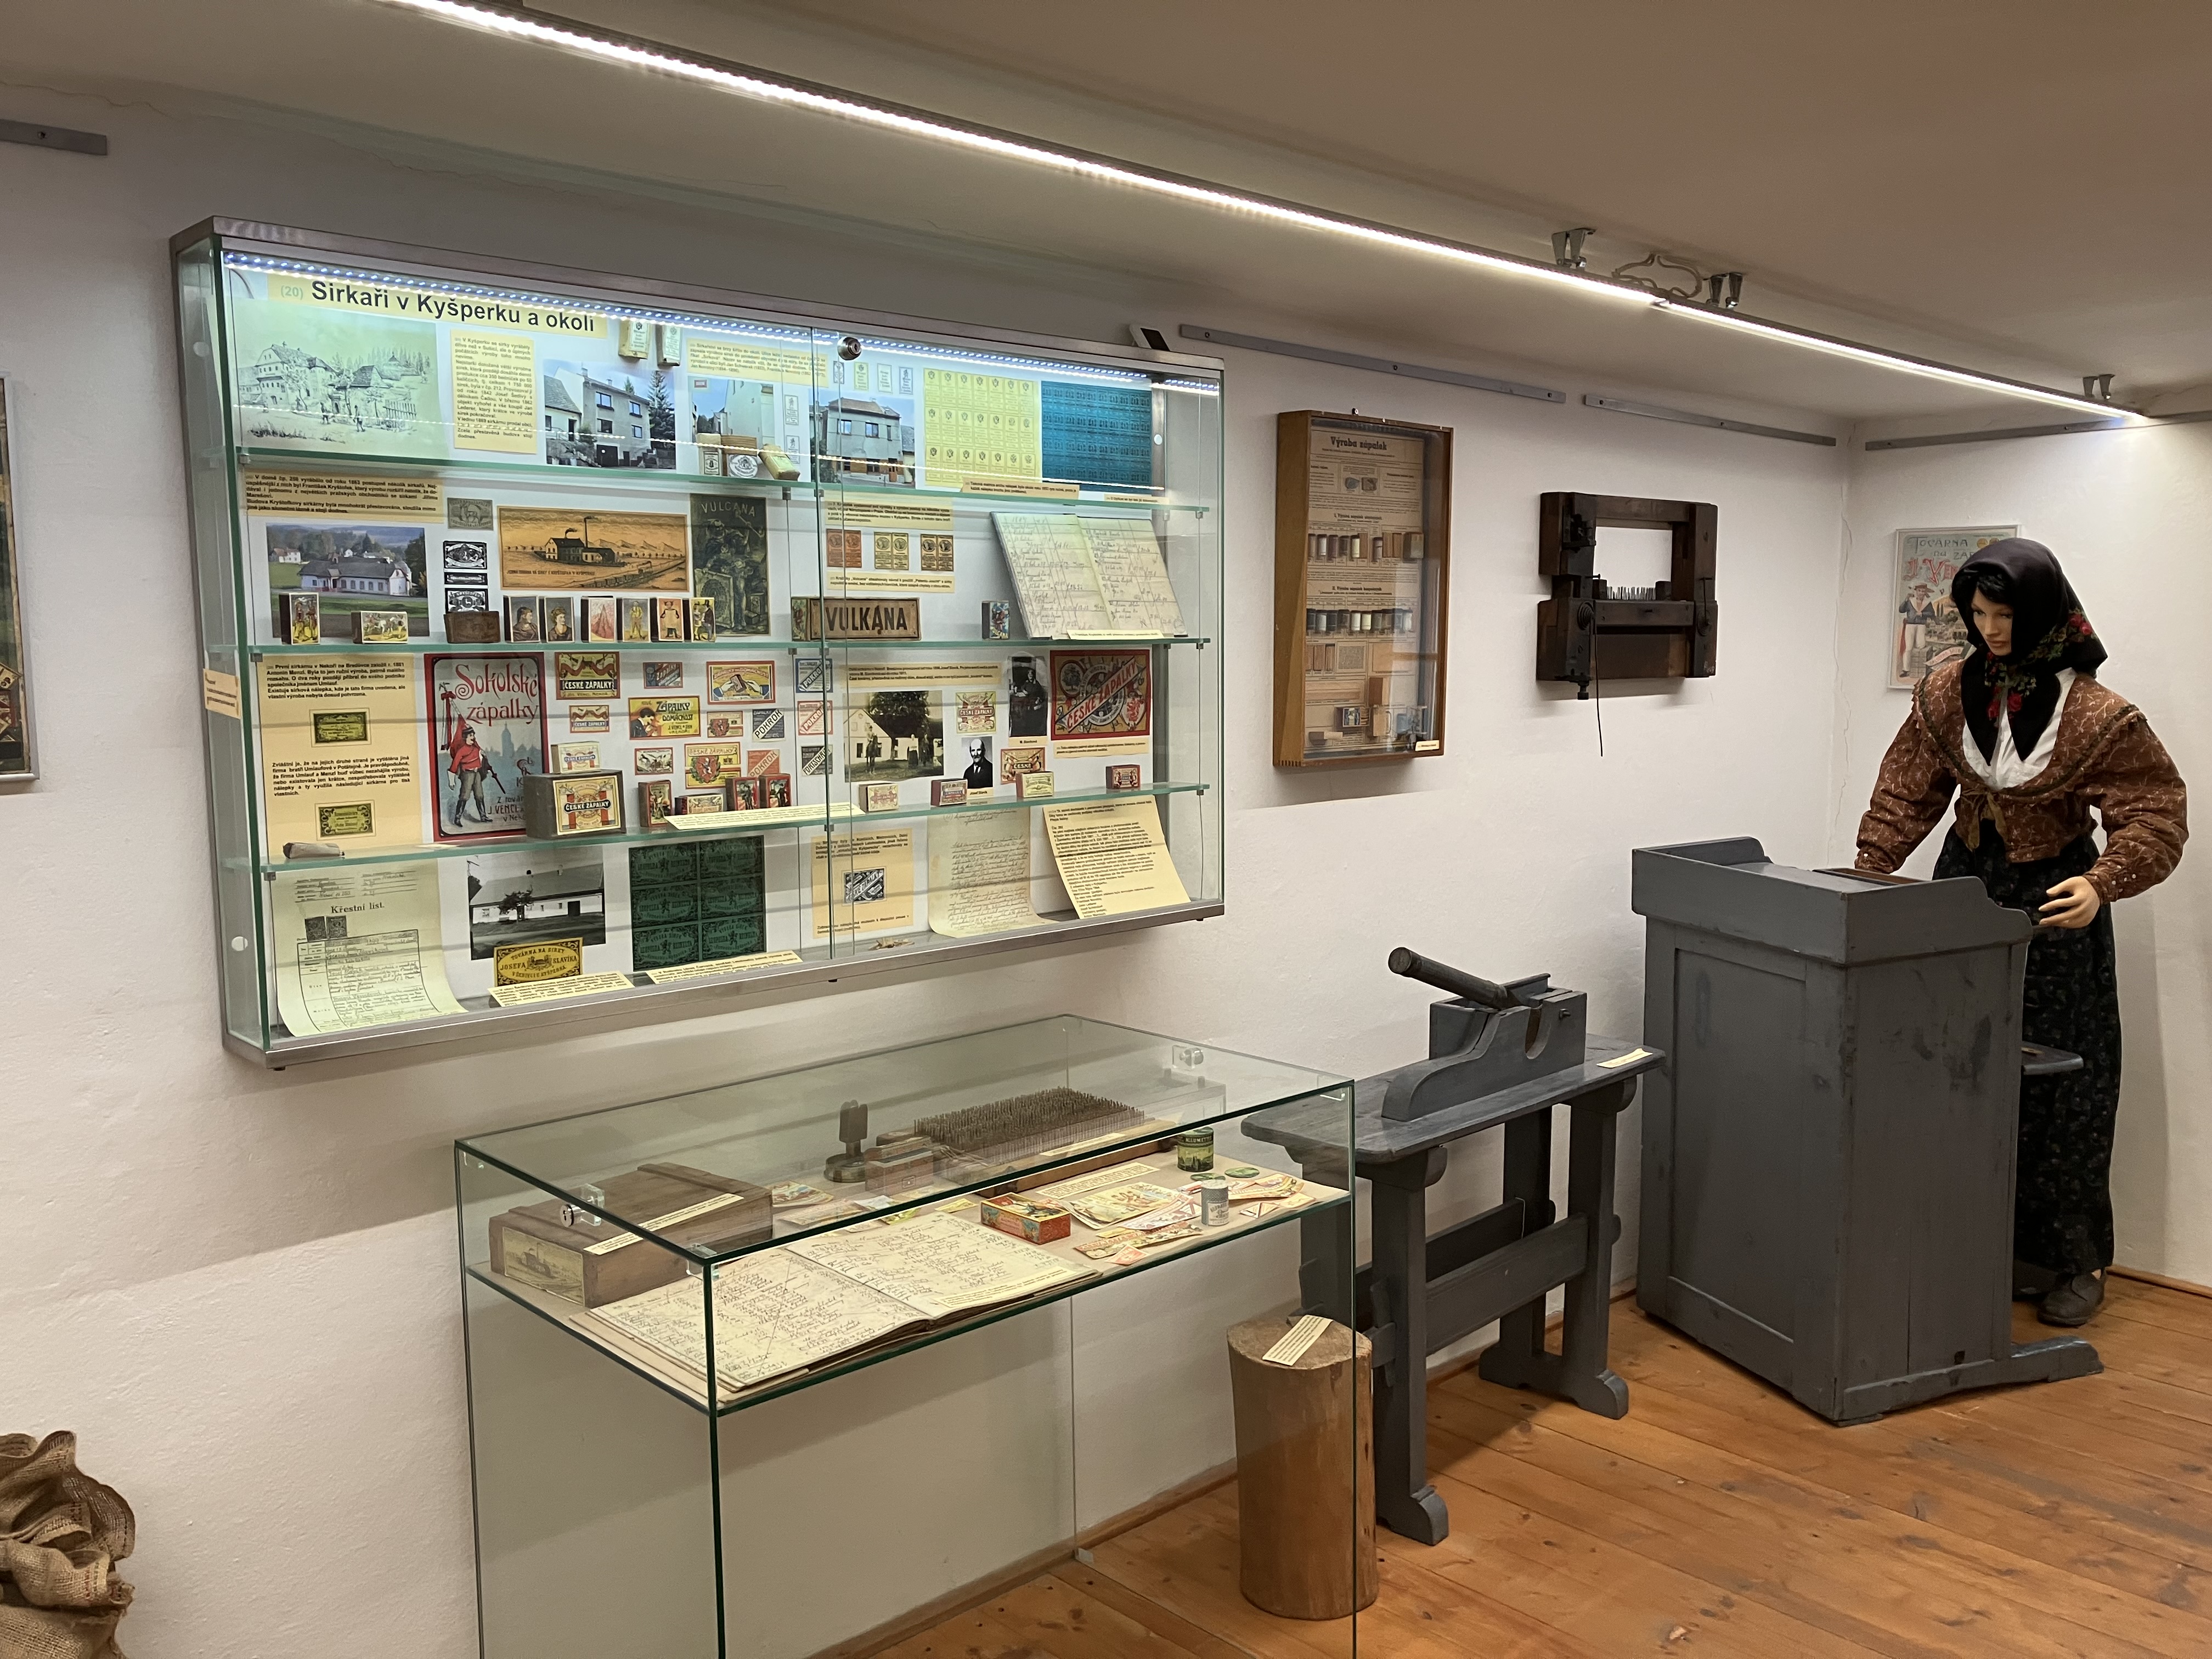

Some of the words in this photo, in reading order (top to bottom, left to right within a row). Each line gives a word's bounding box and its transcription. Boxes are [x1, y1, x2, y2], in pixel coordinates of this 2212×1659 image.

[280, 285, 304, 300] (20)
[312, 280, 388, 308] Sirkaři
[396, 296, 409, 310] v
[417, 294, 520, 323] Kyšperku
[528, 312, 539, 326] a
[1330, 436, 1358, 448] Výroba
[701, 501, 755, 517] VULCANA
[454, 663, 539, 703] Sokolské
[565, 680, 584, 689] ČESKÉ
[585, 680, 612, 690] ZÁPALKY
[1066, 695, 1097, 729] ČESKÉ
[1097, 659, 1137, 704] ZÁPALKY
[466, 698, 539, 727] zápalky
[656, 701, 690, 713] ZÁPALKY
[662, 713, 693, 721] DOMÁCNOST
[754, 708, 783, 739] POKROK
[565, 803, 585, 811] ČESKÉ
[585, 801, 610, 809] ZÁPALKY
[330, 904, 366, 914] Křestní
[369, 901, 385, 910] list.
[511, 949, 537, 960] TOVÁRNA
[500, 962, 526, 971] JOSEFA
[552, 955, 578, 964] SLAVÍKA
